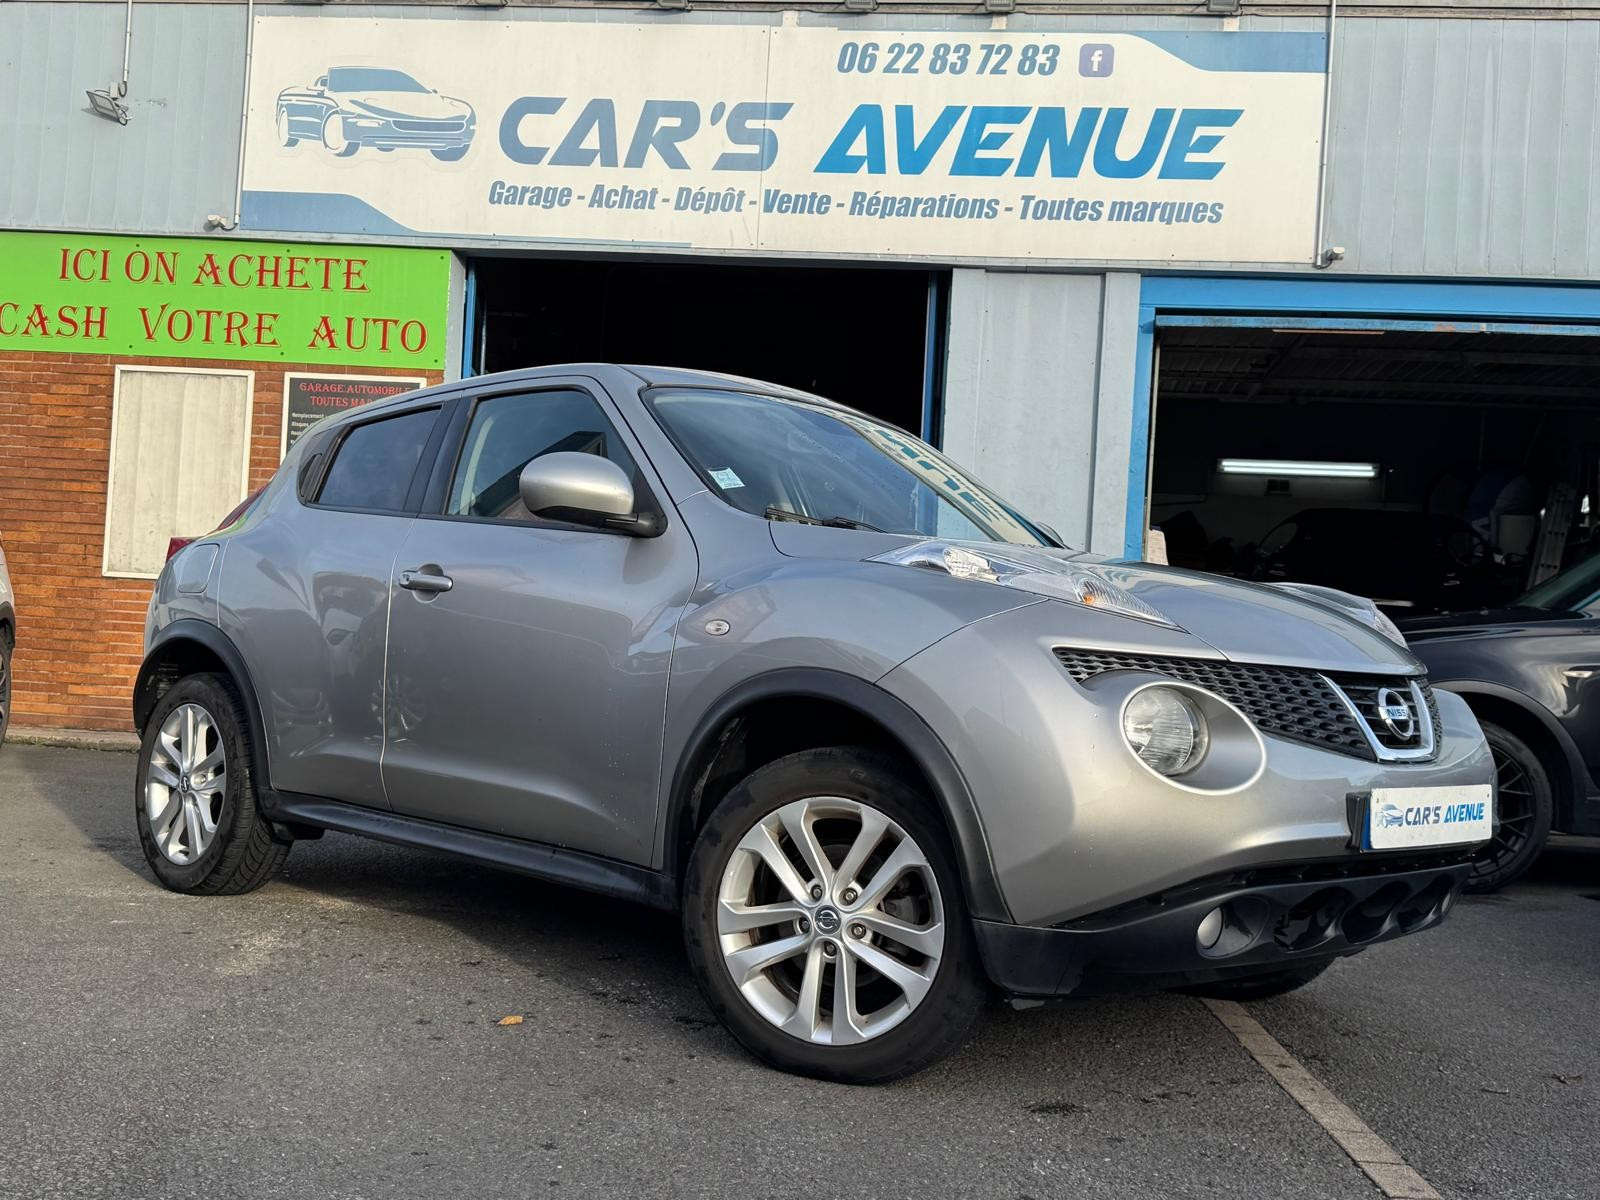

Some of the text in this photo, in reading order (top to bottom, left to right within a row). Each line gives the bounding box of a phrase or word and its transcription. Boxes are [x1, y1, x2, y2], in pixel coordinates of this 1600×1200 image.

[837, 42, 1061, 76] 06 22 83 72 83
[499, 97, 1244, 180] CAR'S AVENUE
[489, 180, 572, 209] Garage
[588, 184, 657, 210] Achat
[674, 187, 745, 214] Dépôt
[762, 189, 832, 215] Vente
[849, 191, 1000, 219] Réparations
[1020, 195, 1105, 221] Toutes
[1107, 200, 1224, 225] marques
[59, 248, 370, 292] ICI ON ACHETE
[0, 302, 429, 354] CASH VOTRE AUTO
[299, 382, 345, 394] GARAGE
[310, 395, 349, 408] TOUTES
[1405, 802, 1485, 826] CAR'S AVENUE
